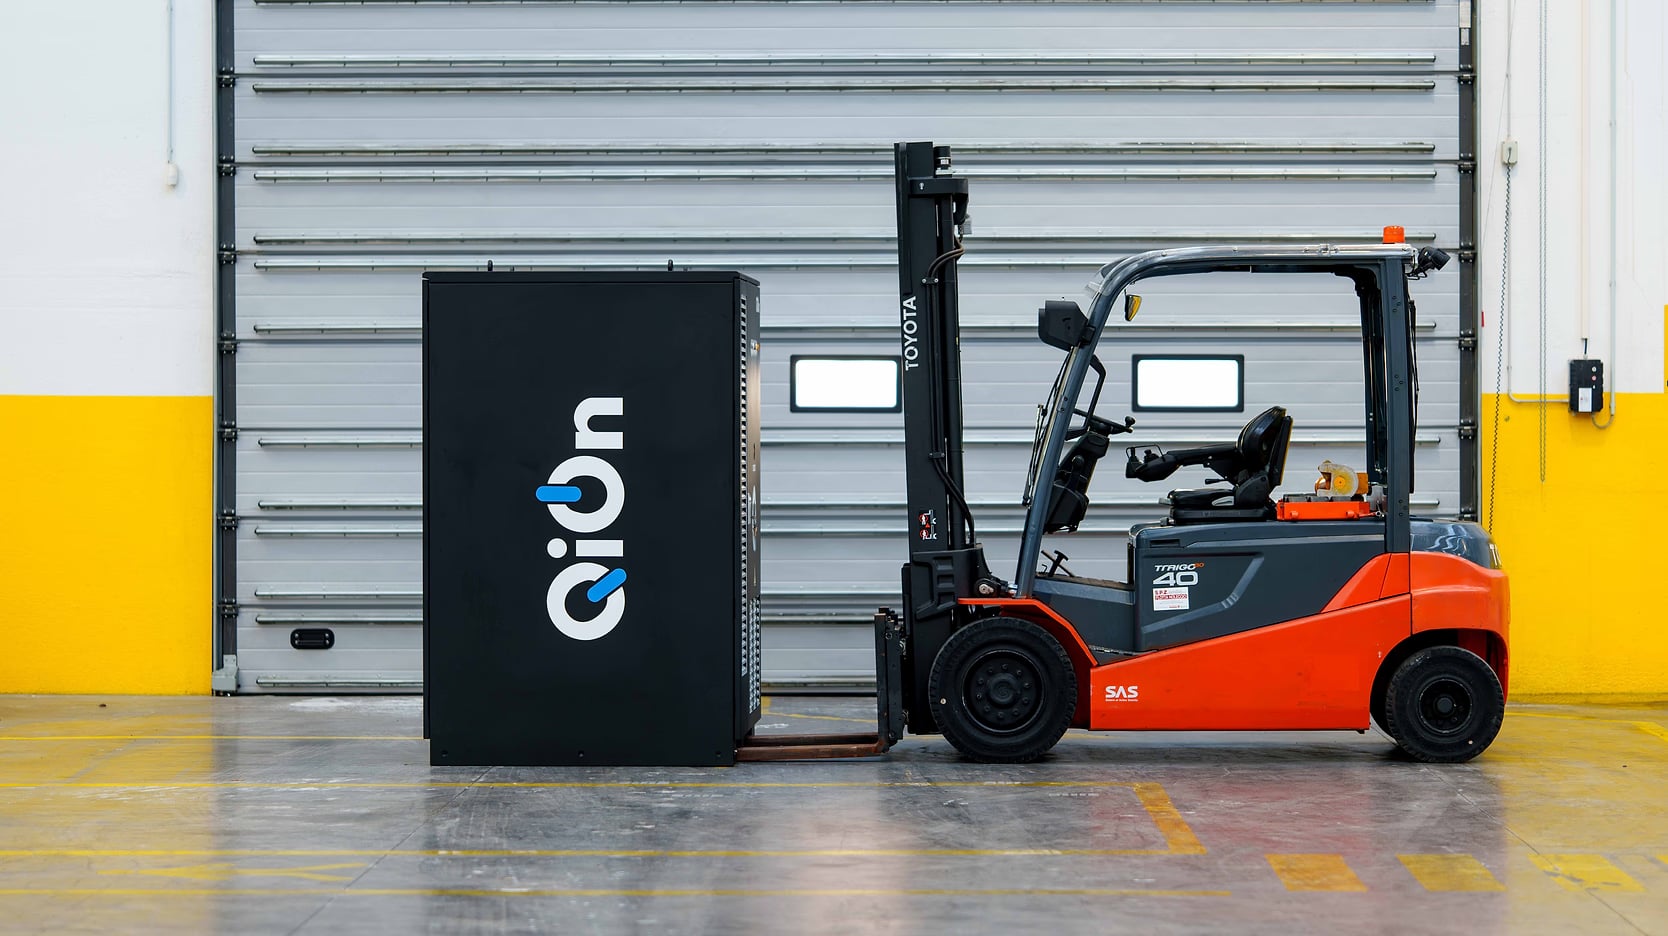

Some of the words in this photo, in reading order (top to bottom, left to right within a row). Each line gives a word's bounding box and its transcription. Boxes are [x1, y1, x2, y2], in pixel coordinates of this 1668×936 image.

[903, 296, 919, 371] TOYOTA
[536, 397, 627, 641] QiOn
[1153, 571, 1199, 586] 40
[1105, 685, 1139, 698] SAS
